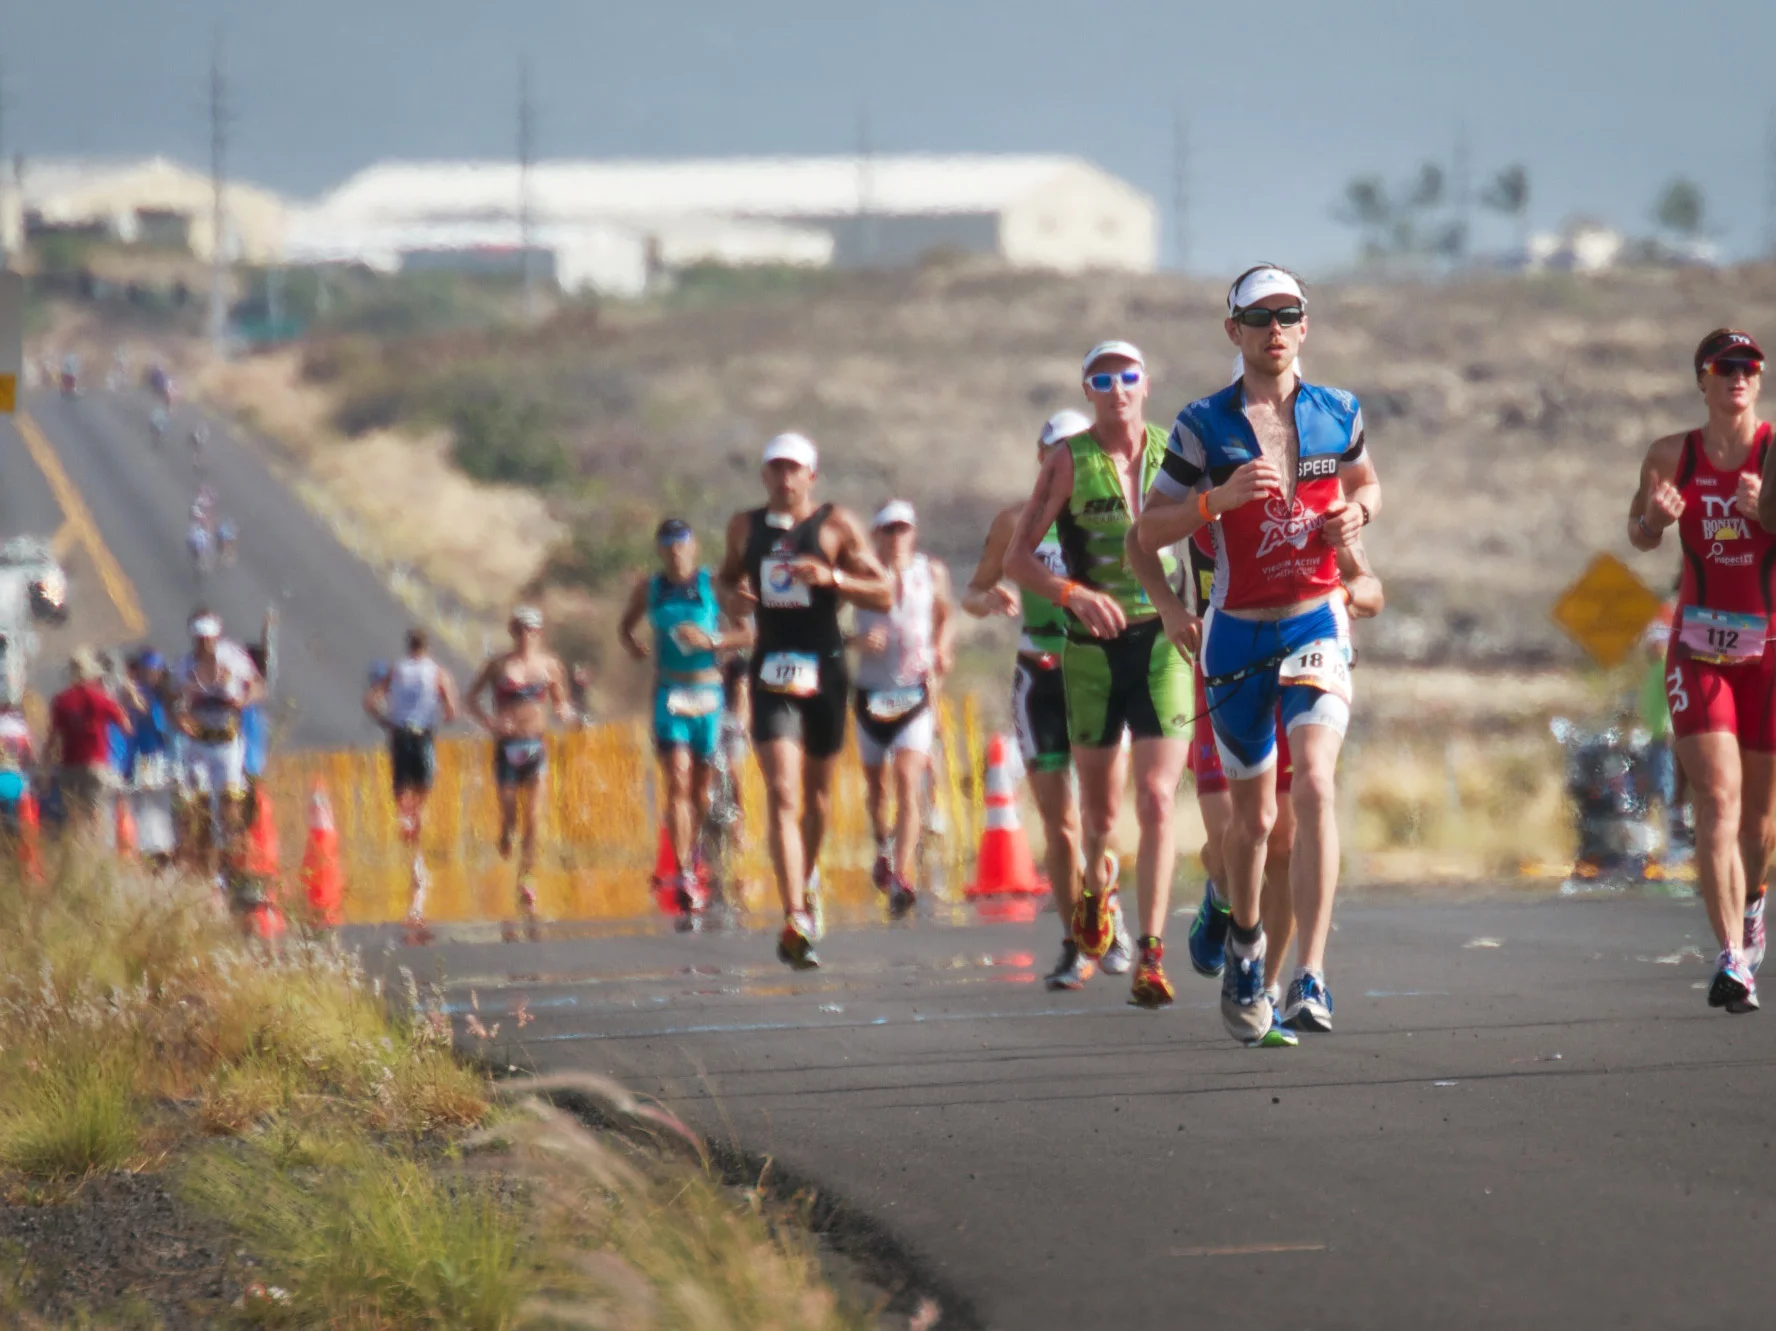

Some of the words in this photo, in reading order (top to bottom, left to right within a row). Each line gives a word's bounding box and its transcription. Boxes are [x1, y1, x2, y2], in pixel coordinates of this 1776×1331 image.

[1701, 495, 1737, 517] TY
[1703, 518, 1751, 540] BONITA
[1707, 628, 1738, 649] 112
[1298, 653, 1323, 668] 18
